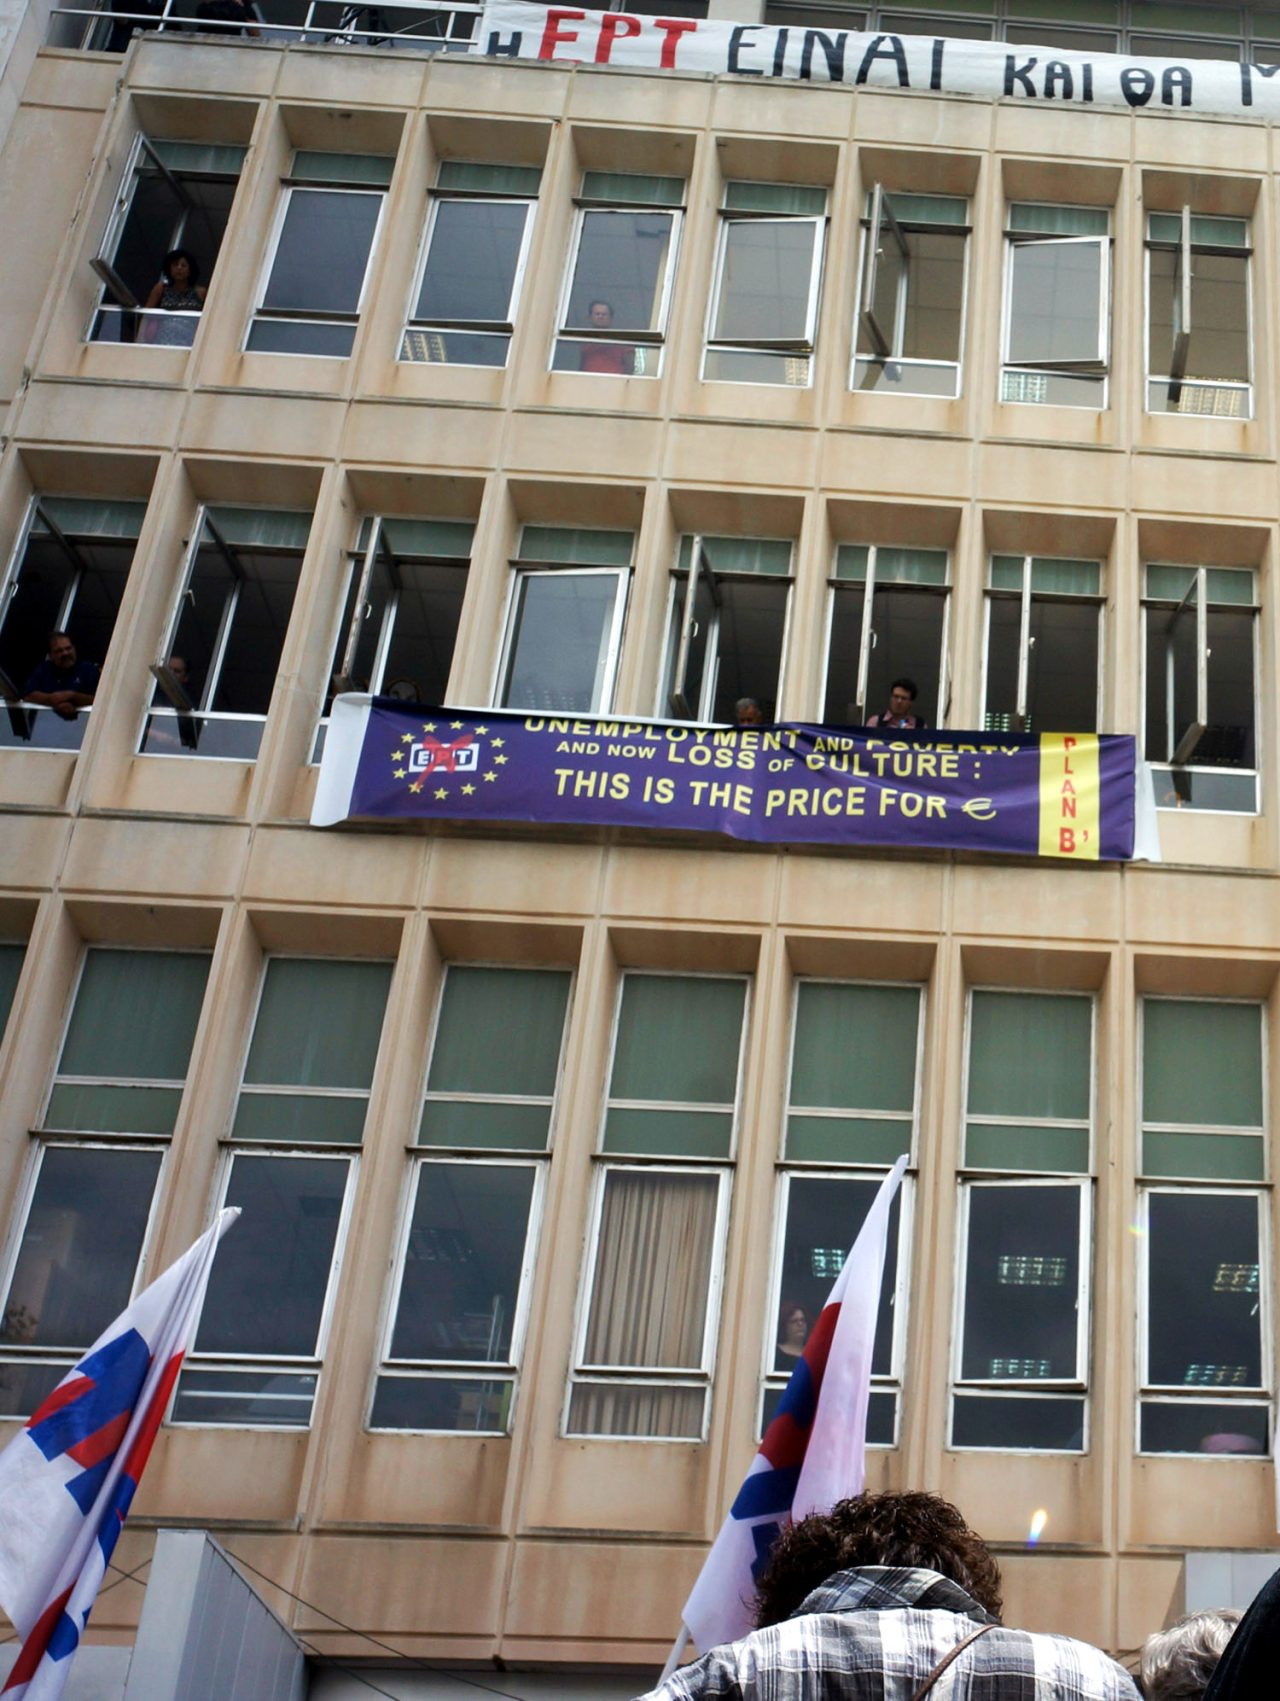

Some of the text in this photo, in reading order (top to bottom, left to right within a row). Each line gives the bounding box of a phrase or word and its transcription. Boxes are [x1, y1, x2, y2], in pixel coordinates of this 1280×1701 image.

[538, 9, 697, 69] ΕΡΤ
[727, 26, 946, 90] ΕΙΝΑΙ
[1004, 54, 1094, 102] ΚΑΙ
[1120, 67, 1193, 108] ΘΑ
[556, 741, 600, 755] AND
[607, 744, 656, 759] NOW
[667, 742, 756, 770] LOSS
[768, 758, 794, 772] OF
[806, 752, 959, 778] CULTURE
[813, 737, 854, 752] AND
[554, 769, 630, 799] THIS
[642, 777, 674, 804] IS
[690, 781, 752, 815] THE
[765, 786, 866, 817] PRICE
[879, 788, 947, 819] FOR
